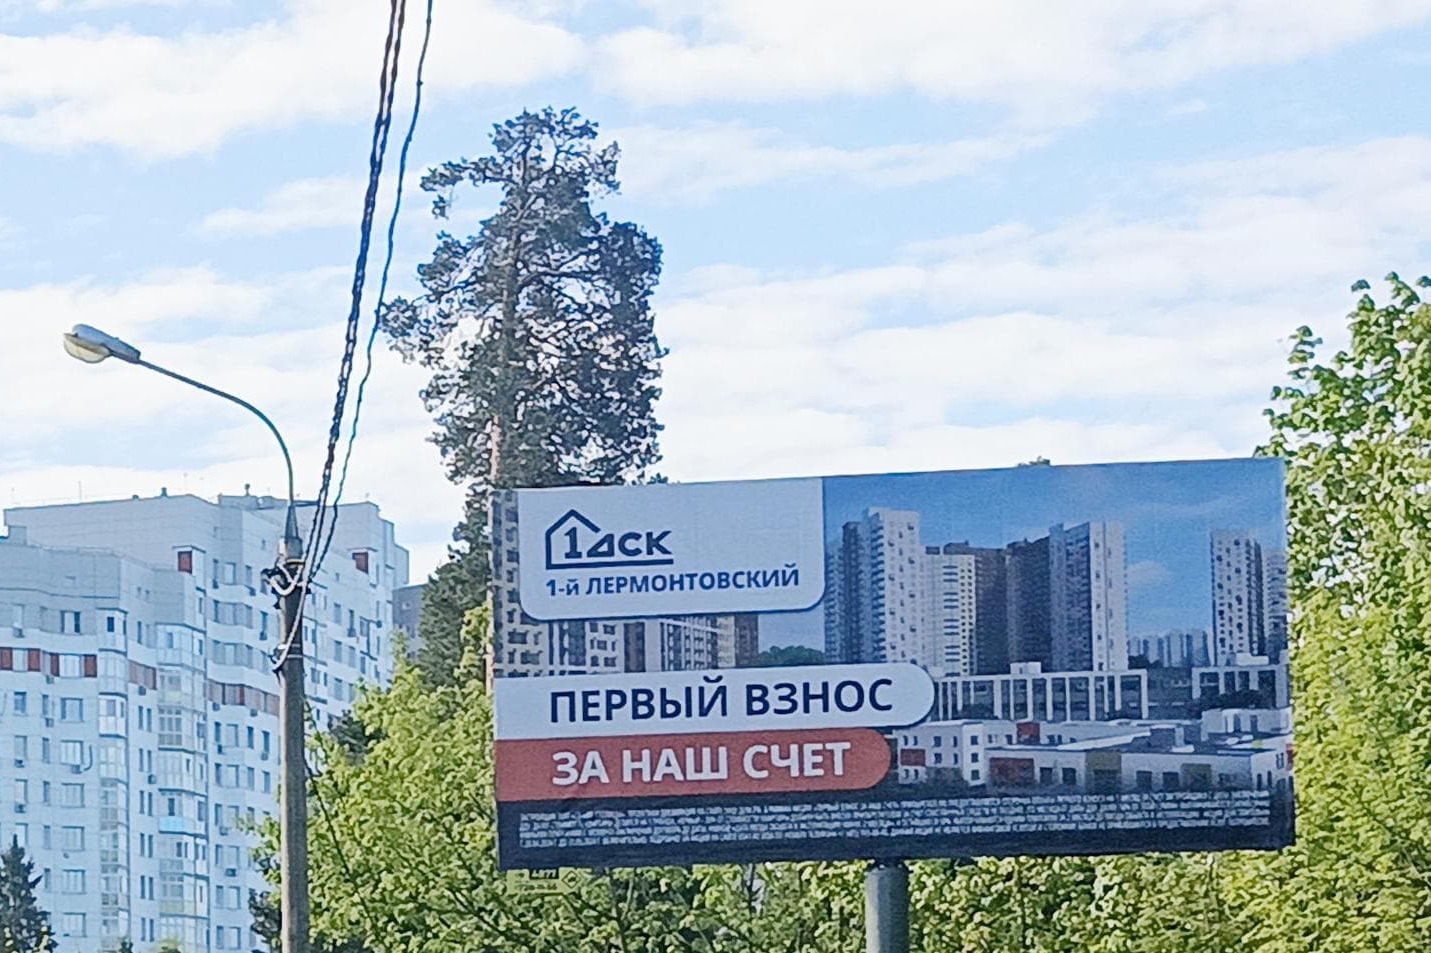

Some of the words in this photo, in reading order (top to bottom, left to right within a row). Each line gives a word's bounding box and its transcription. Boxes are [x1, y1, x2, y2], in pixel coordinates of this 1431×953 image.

[564, 526, 673, 559] 1ДСК
[545, 578, 580, 596] 1-й
[585, 562, 800, 596] ЛЕРМОНТОВСКИЙ
[550, 674, 728, 723] ПЕРВЫЙ
[745, 678, 893, 716] ВЗНОС
[552, 750, 610, 787] ЗА
[622, 746, 729, 784] НАШ
[742, 742, 852, 780] СЧЕТ
